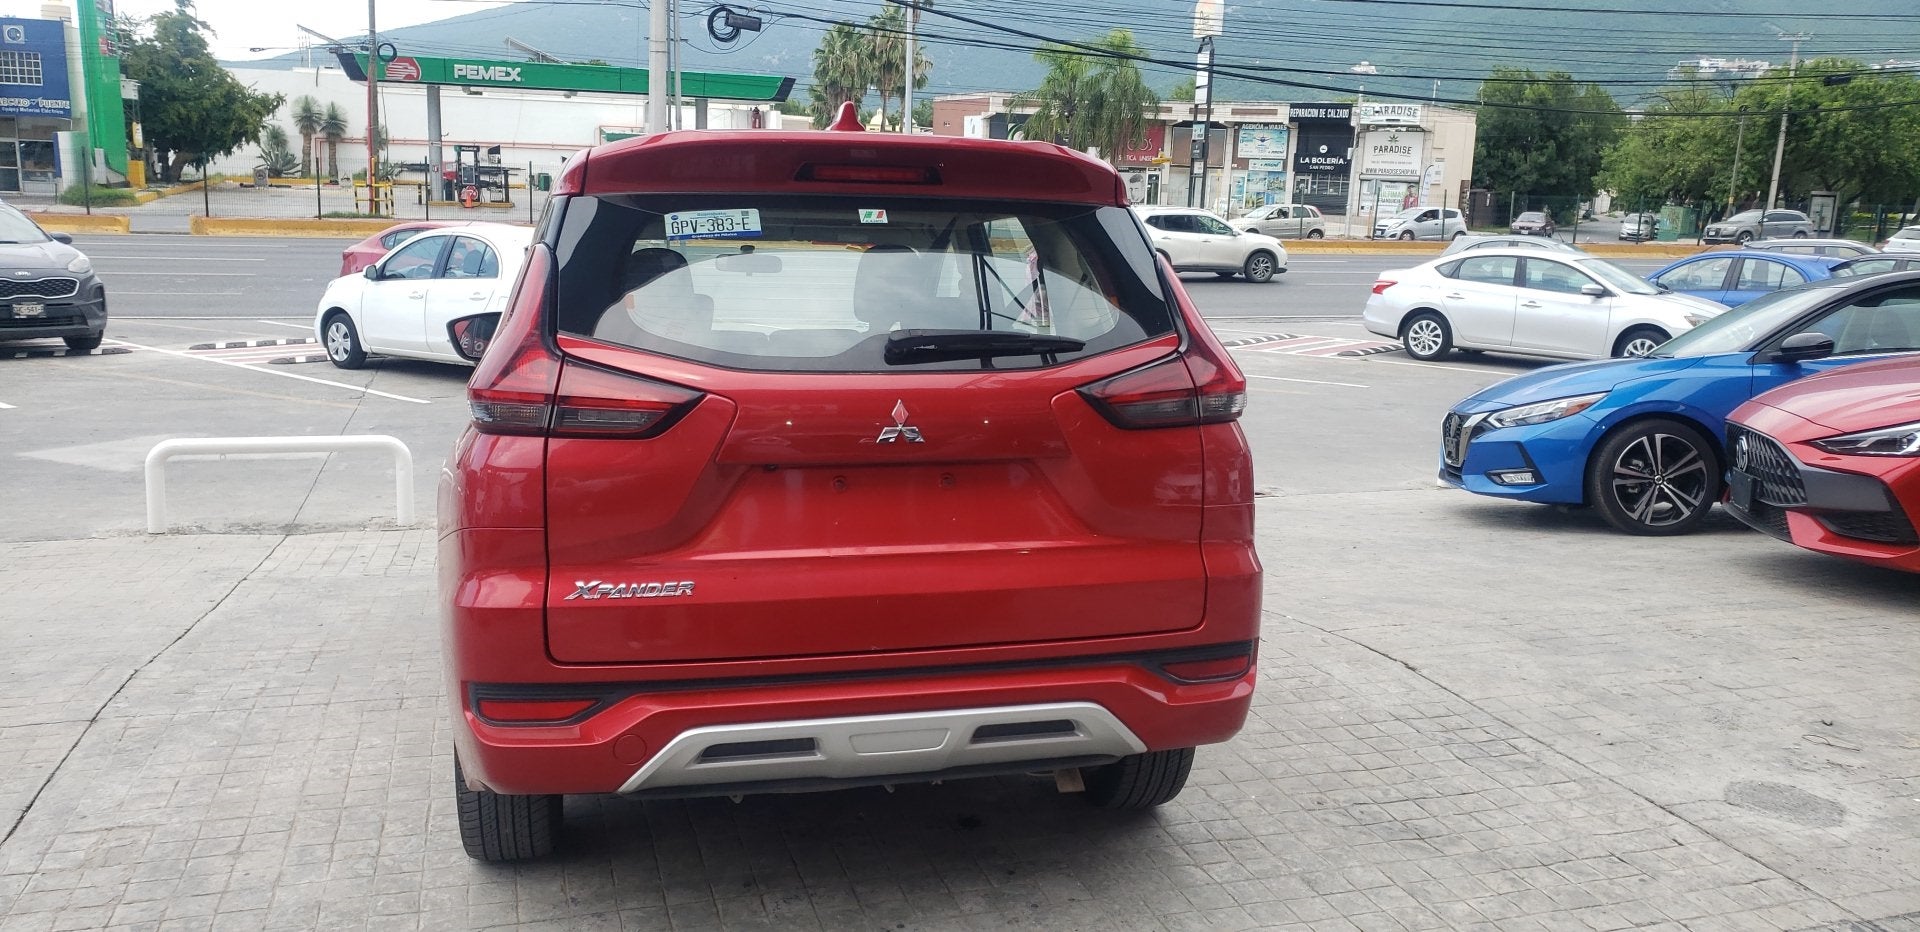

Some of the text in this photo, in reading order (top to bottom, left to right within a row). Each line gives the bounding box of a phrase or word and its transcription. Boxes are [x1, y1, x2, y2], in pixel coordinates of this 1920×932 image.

[454, 64, 521, 81] PEMEX
[0, 97, 29, 107] ECTRO
[1290, 108, 1349, 118] REPARACION DE CALZADO
[1373, 145, 1412, 155] PARADISE
[671, 217, 751, 234] GPV-383-E
[564, 581, 695, 600] XPANDER
